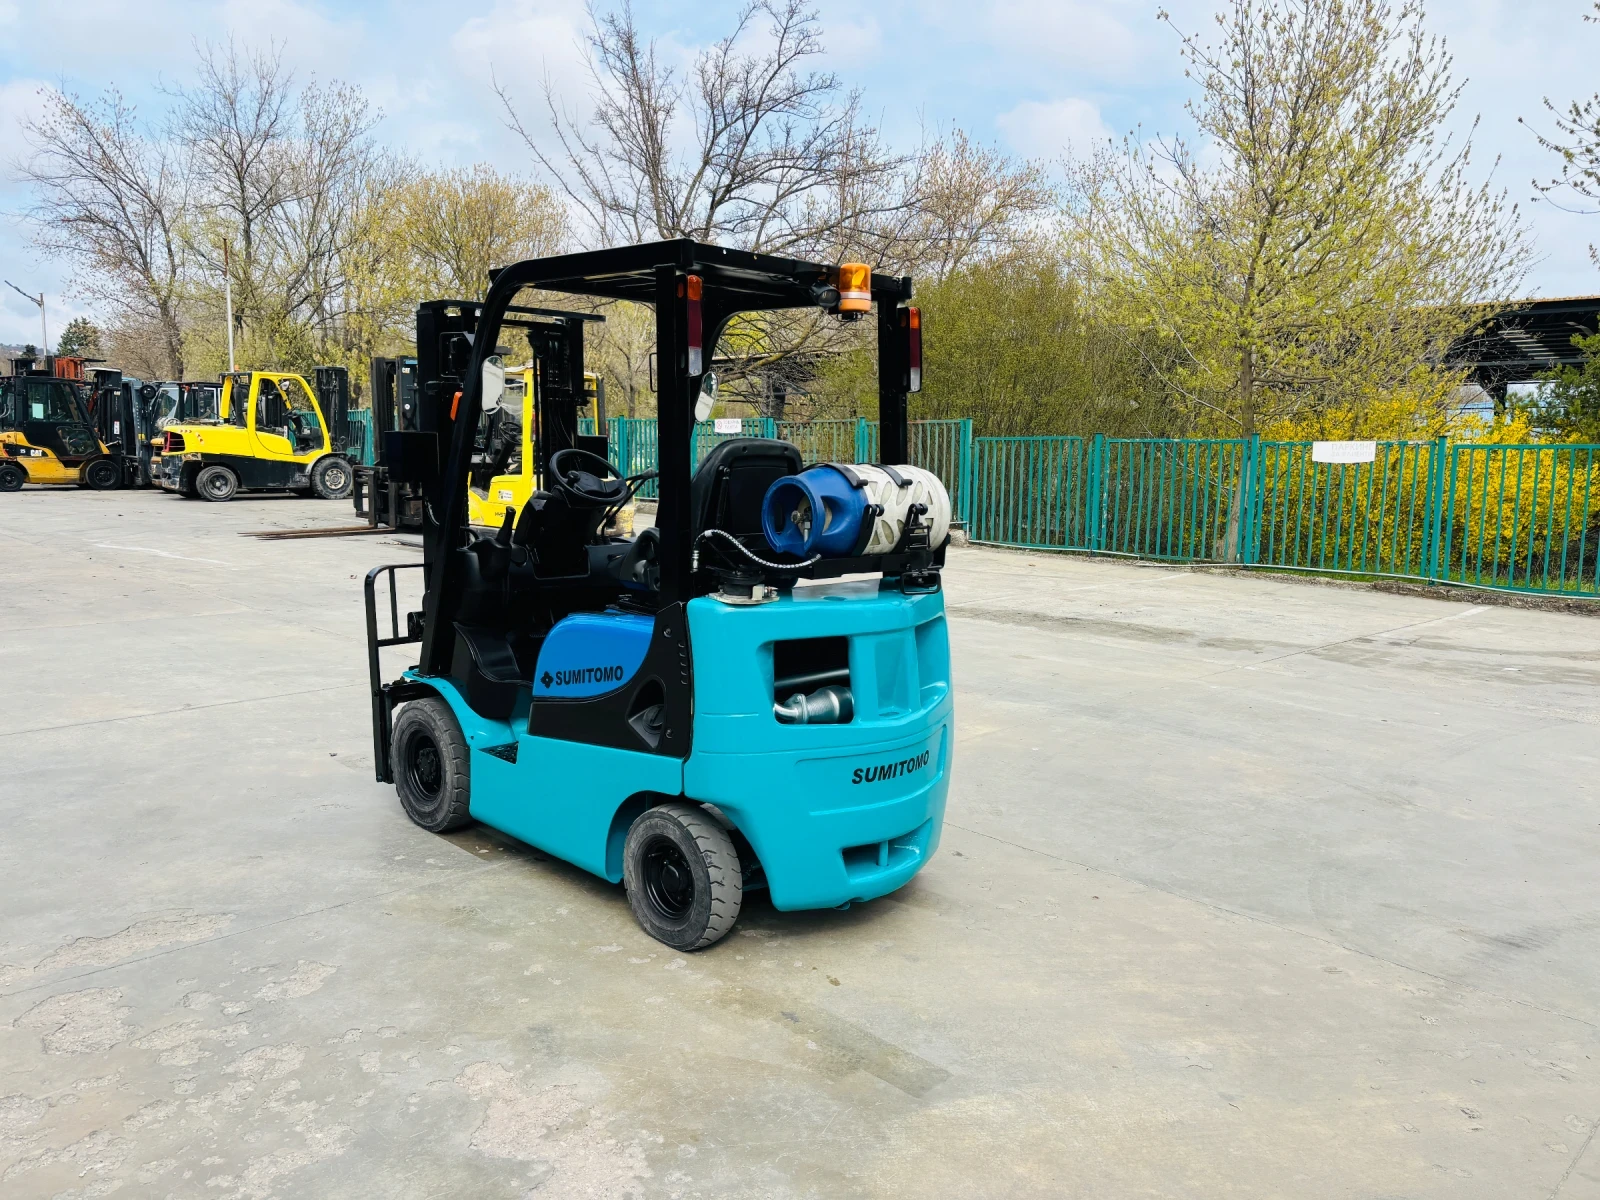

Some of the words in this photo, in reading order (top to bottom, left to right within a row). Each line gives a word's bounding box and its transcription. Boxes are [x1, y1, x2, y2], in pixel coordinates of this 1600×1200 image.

[30, 449, 43, 457] CAT
[555, 665, 624, 686] SUMITOMO
[851, 749, 930, 785] SUMITOMO
